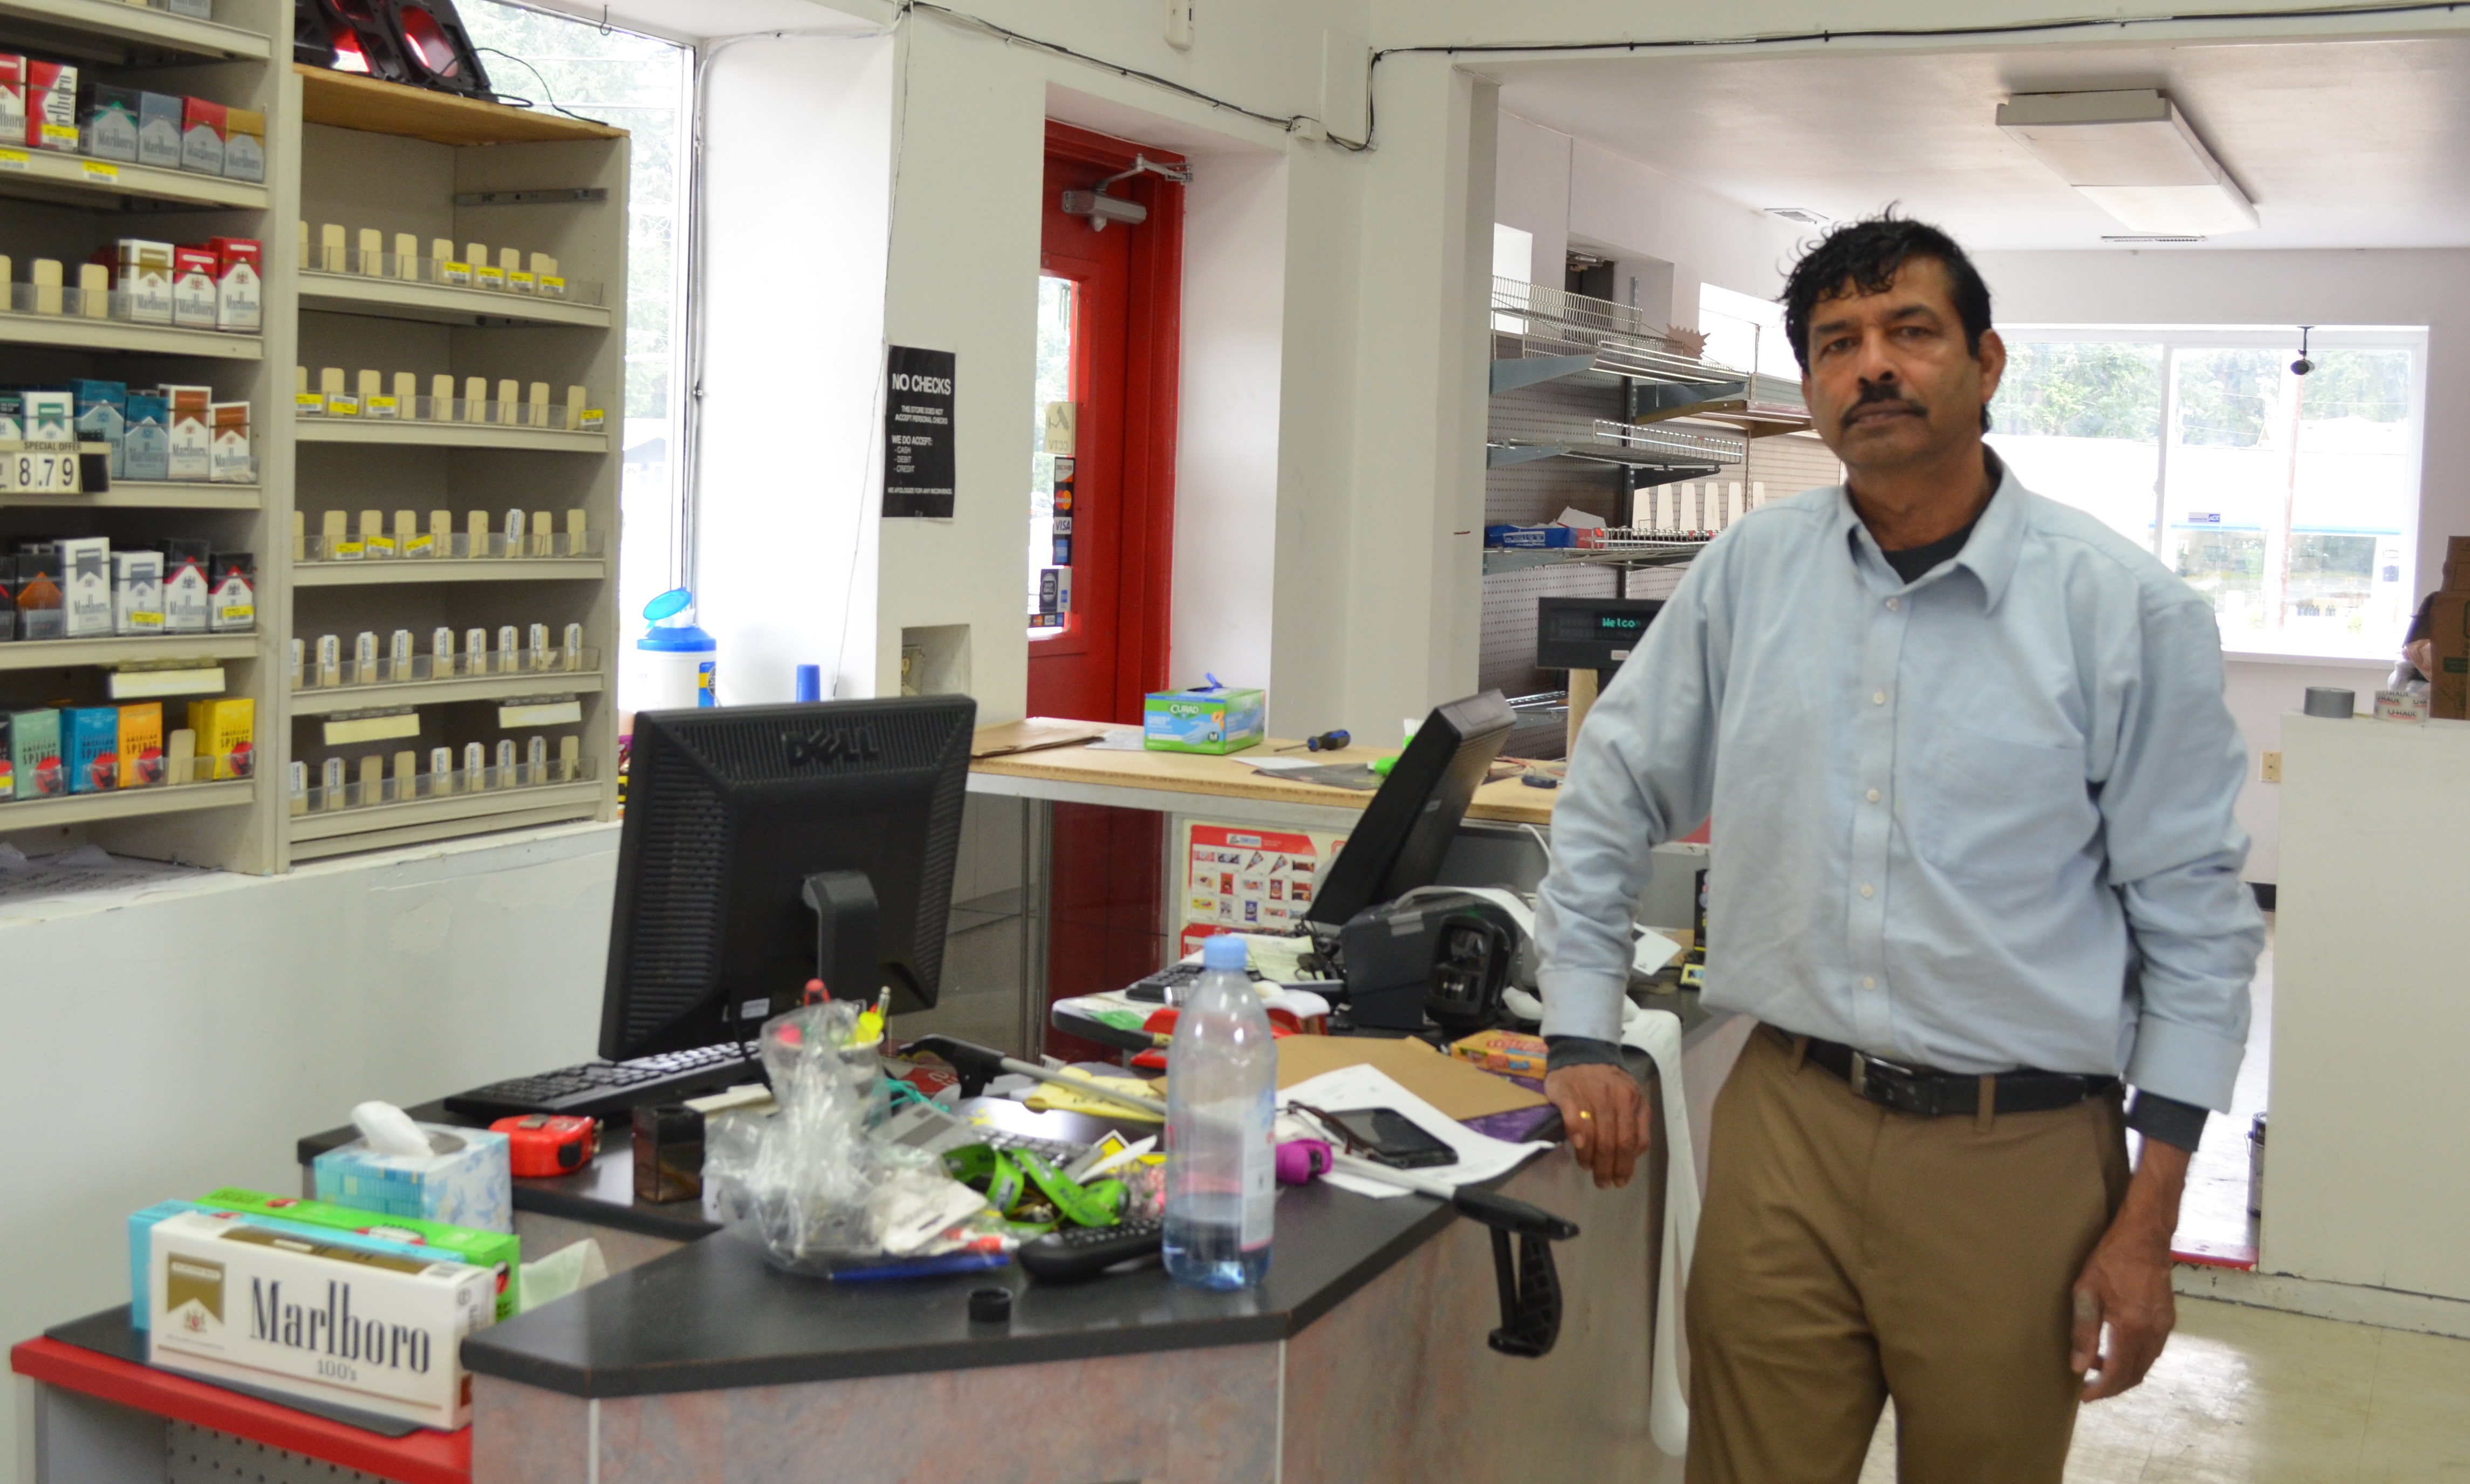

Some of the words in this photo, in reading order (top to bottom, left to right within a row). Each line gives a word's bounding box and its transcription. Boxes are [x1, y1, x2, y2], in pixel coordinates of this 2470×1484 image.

[892, 373, 909, 391] NO
[912, 375, 951, 395] CHECKS
[912, 415, 932, 423] PERSONAL
[24, 441, 57, 450] SPECIAL
[173, 437, 206, 456] Marlboro
[892, 435, 902, 444] WE
[902, 435, 911, 444] DO
[912, 436, 932, 446] ACCEPT:
[19, 457, 74, 486] 8.79
[1056, 520, 1071, 530] VISA
[1170, 704, 1200, 714] CURAD
[2388, 709, 2417, 717] U-HAUL
[782, 728, 879, 758] DELL
[250, 1275, 430, 1374] Marlboro
[317, 1358, 357, 1382] 100's
